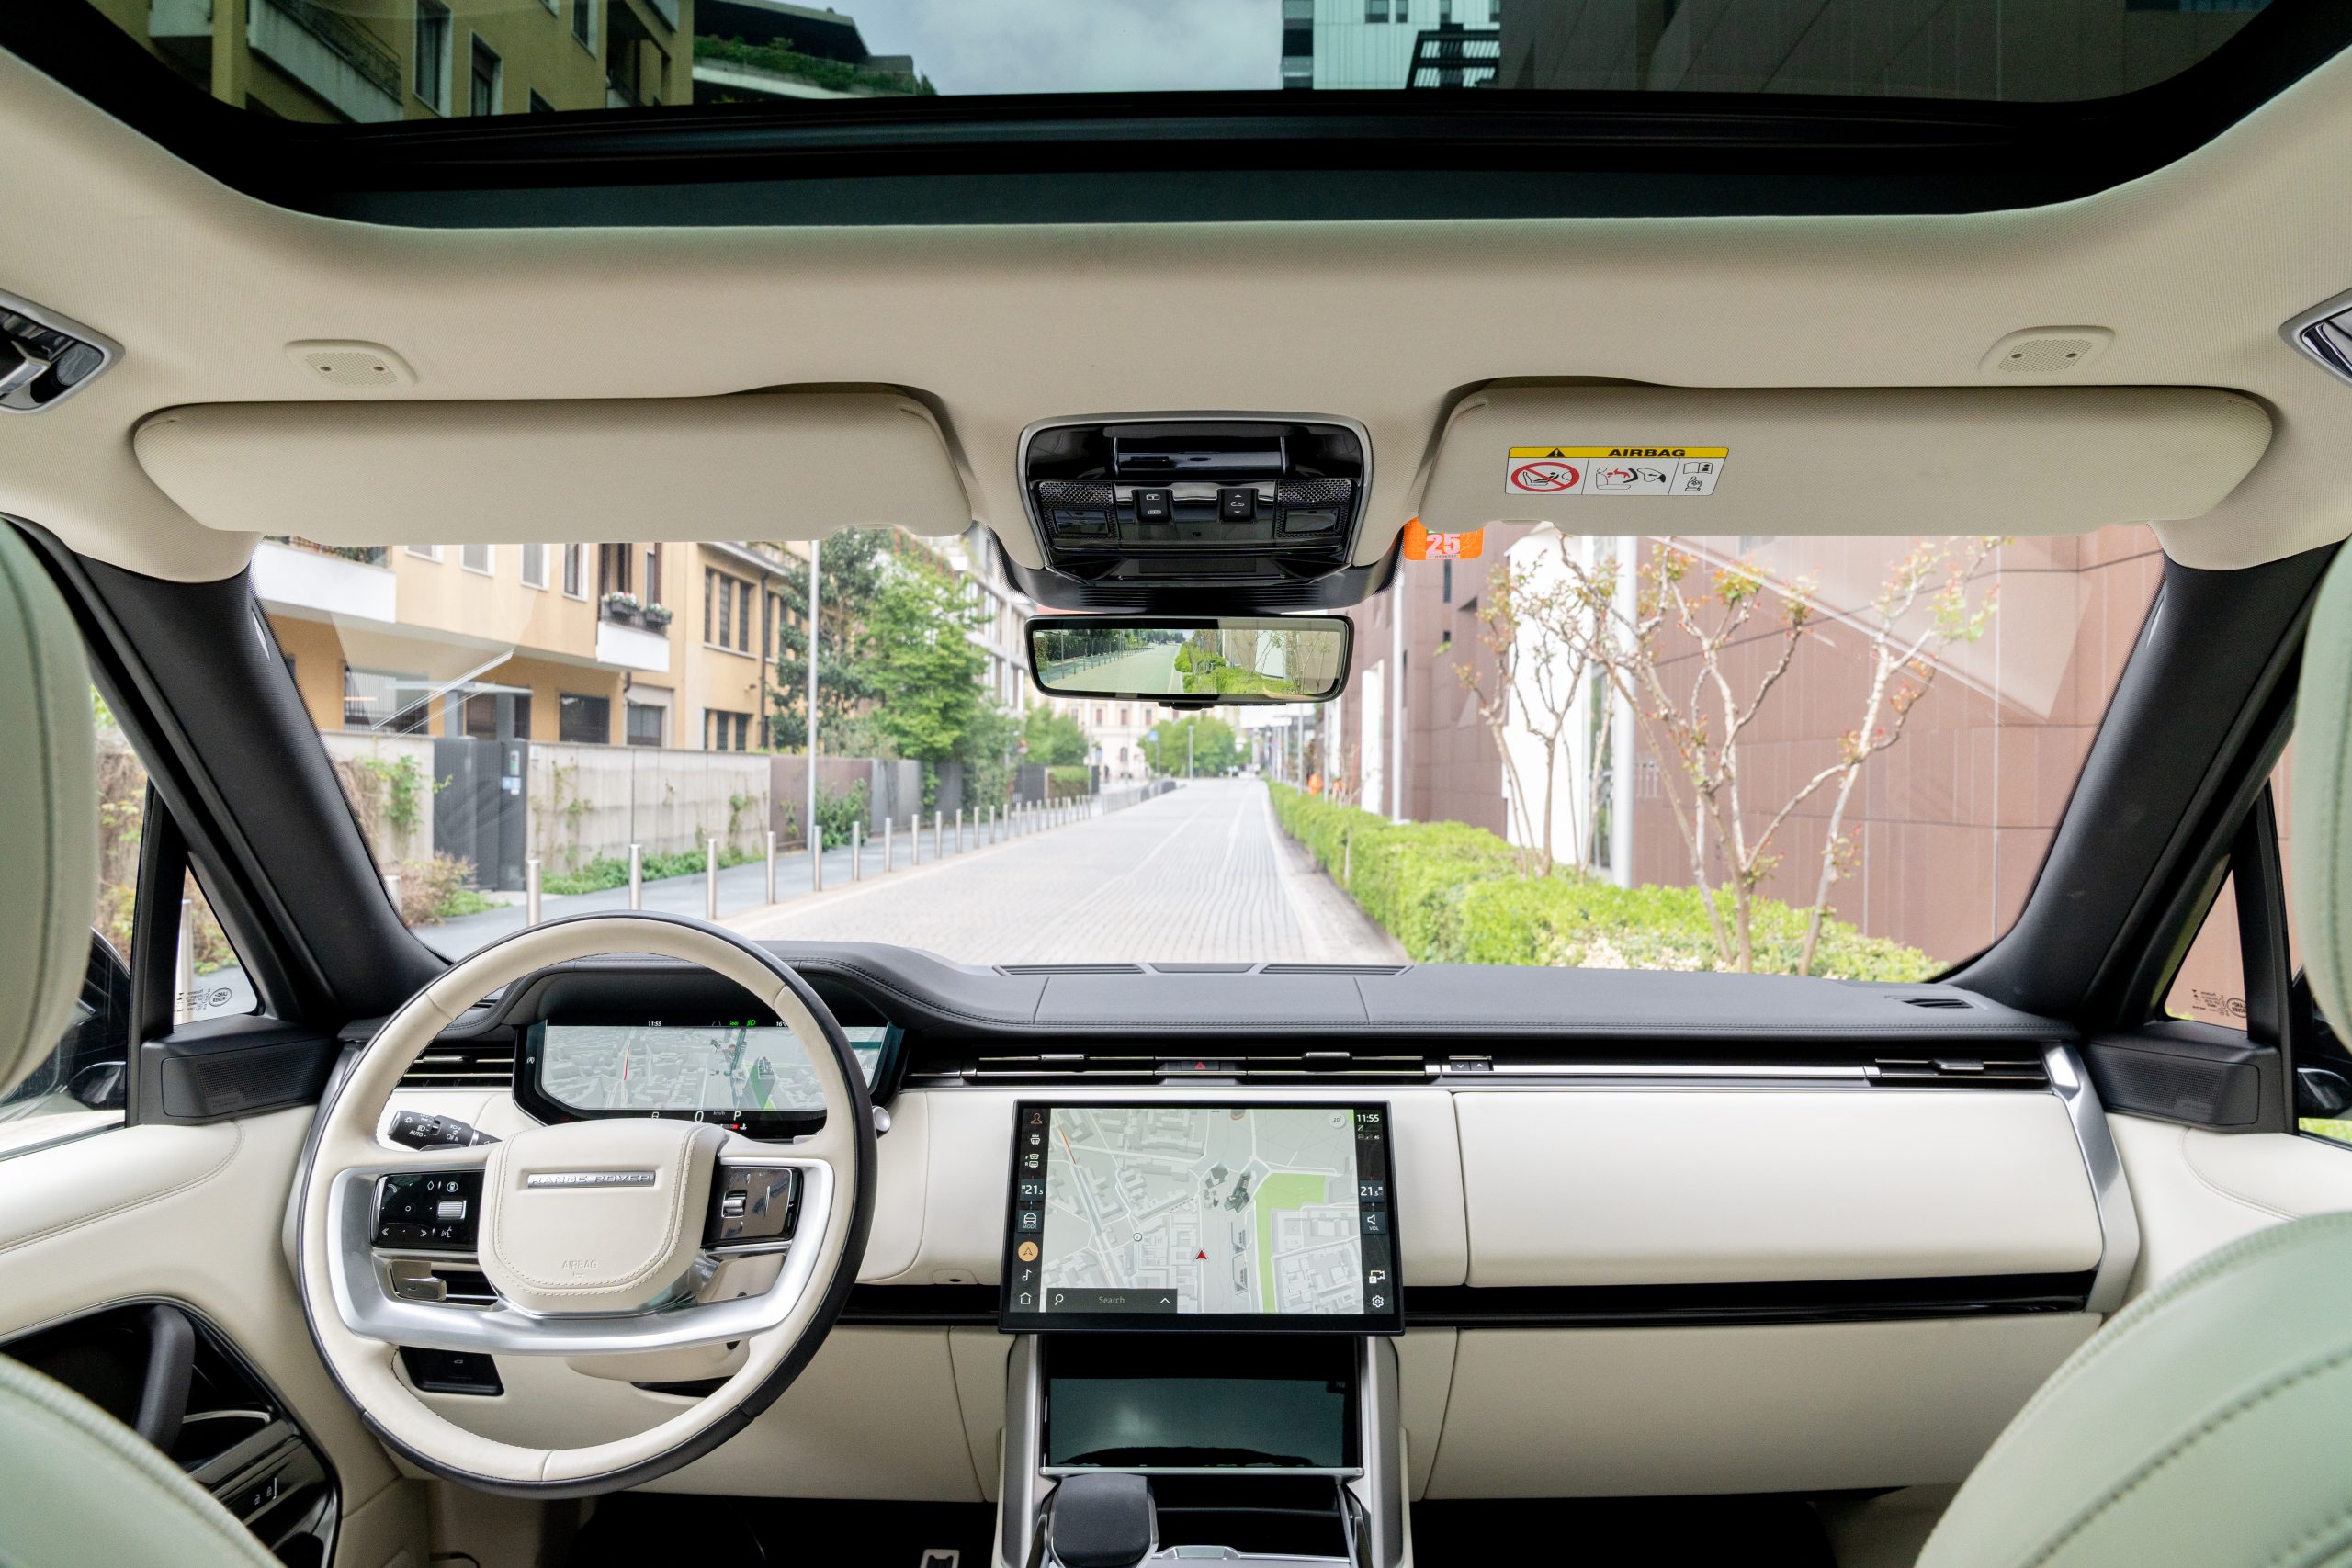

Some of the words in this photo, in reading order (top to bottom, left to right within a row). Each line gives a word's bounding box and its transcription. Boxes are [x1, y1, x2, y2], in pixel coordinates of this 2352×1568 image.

[1608, 448, 1686, 457] AIRBAG
[1426, 534, 1460, 555] 25
[695, 1111, 704, 1122] 0
[733, 1111, 741, 1121] P
[1357, 1113, 1380, 1122] 11:55
[532, 1175, 588, 1185] RANGE
[594, 1174, 651, 1183] ROVER
[561, 1259, 597, 1269] AIRBAG
[1098, 1296, 1125, 1304] Search
